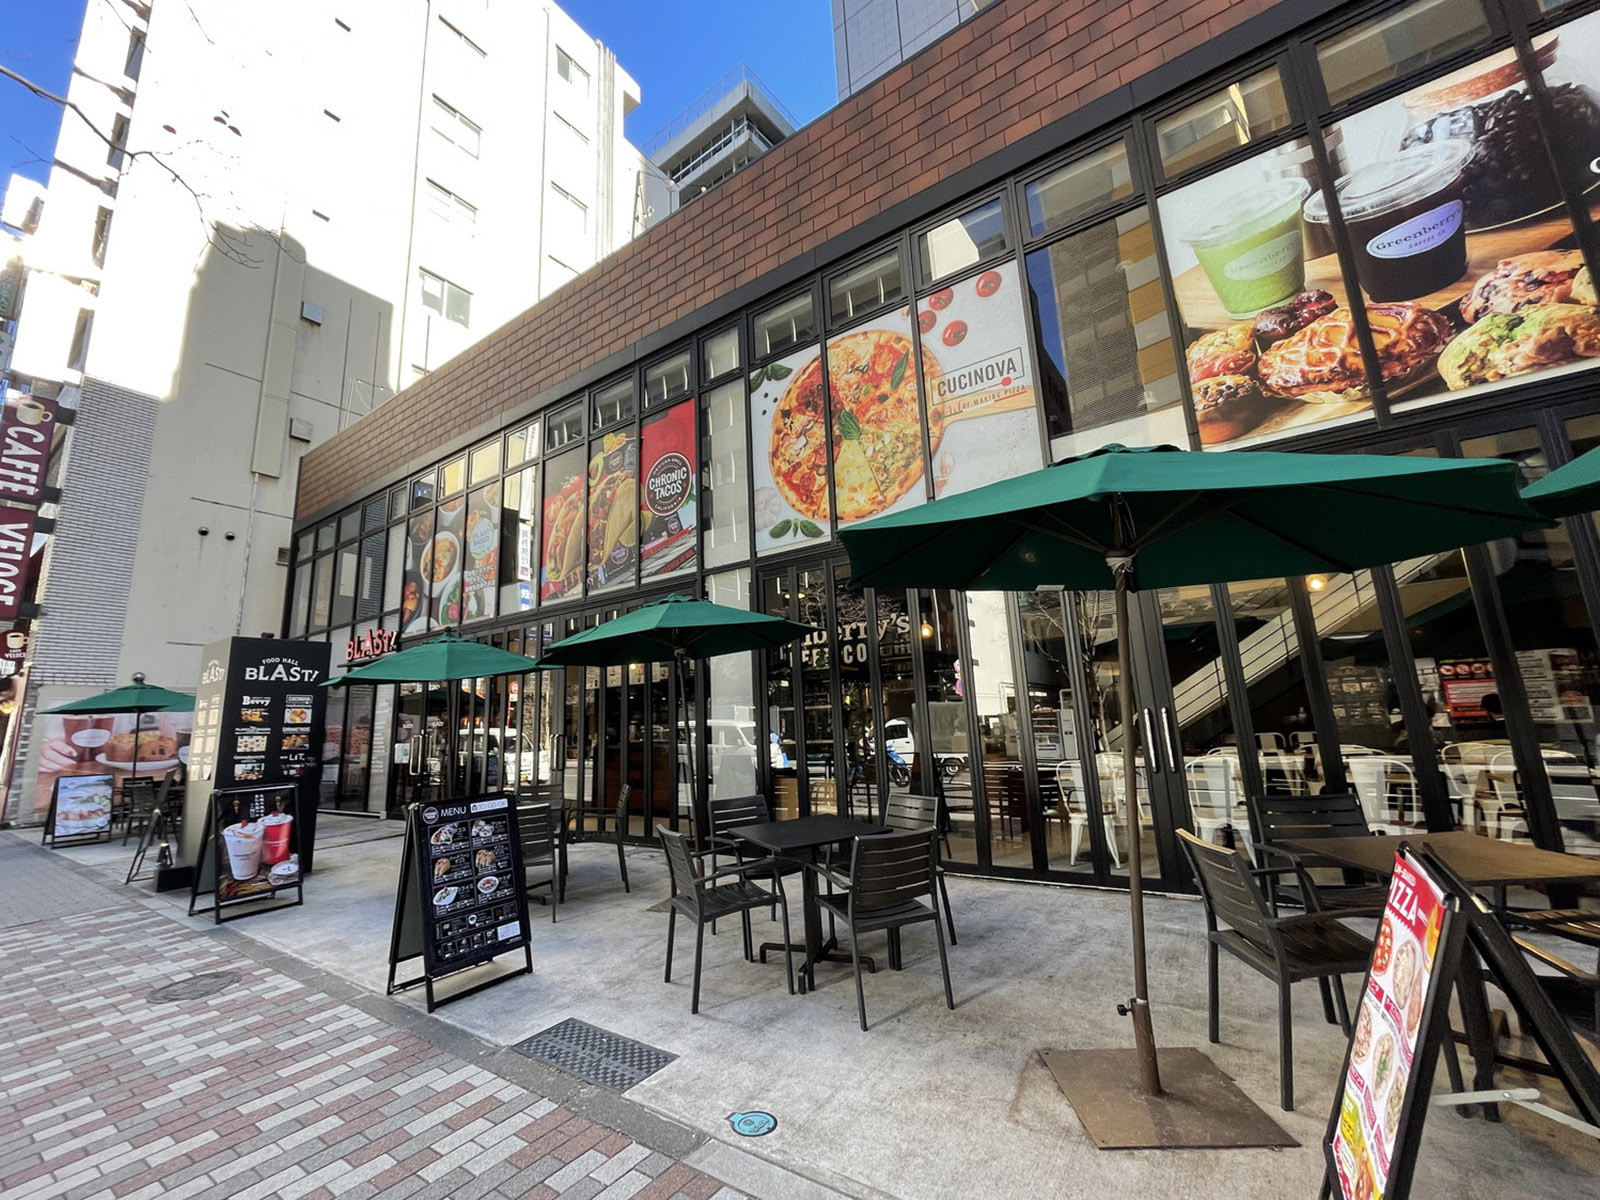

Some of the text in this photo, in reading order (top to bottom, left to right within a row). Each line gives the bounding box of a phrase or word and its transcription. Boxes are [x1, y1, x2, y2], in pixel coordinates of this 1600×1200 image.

[937, 357, 1017, 397] CUCINOVA
[974, 392, 1001, 405] MAKING
[1004, 384, 1026, 396] PIZZA
[649, 466, 688, 490] CHRONIC
[654, 480, 683, 501] TACOS
[345, 629, 398, 661] BLAST!
[245, 663, 319, 682] BLAST!
[262, 657, 299, 667] FOOD HALL
[440, 805, 467, 818] MENU
